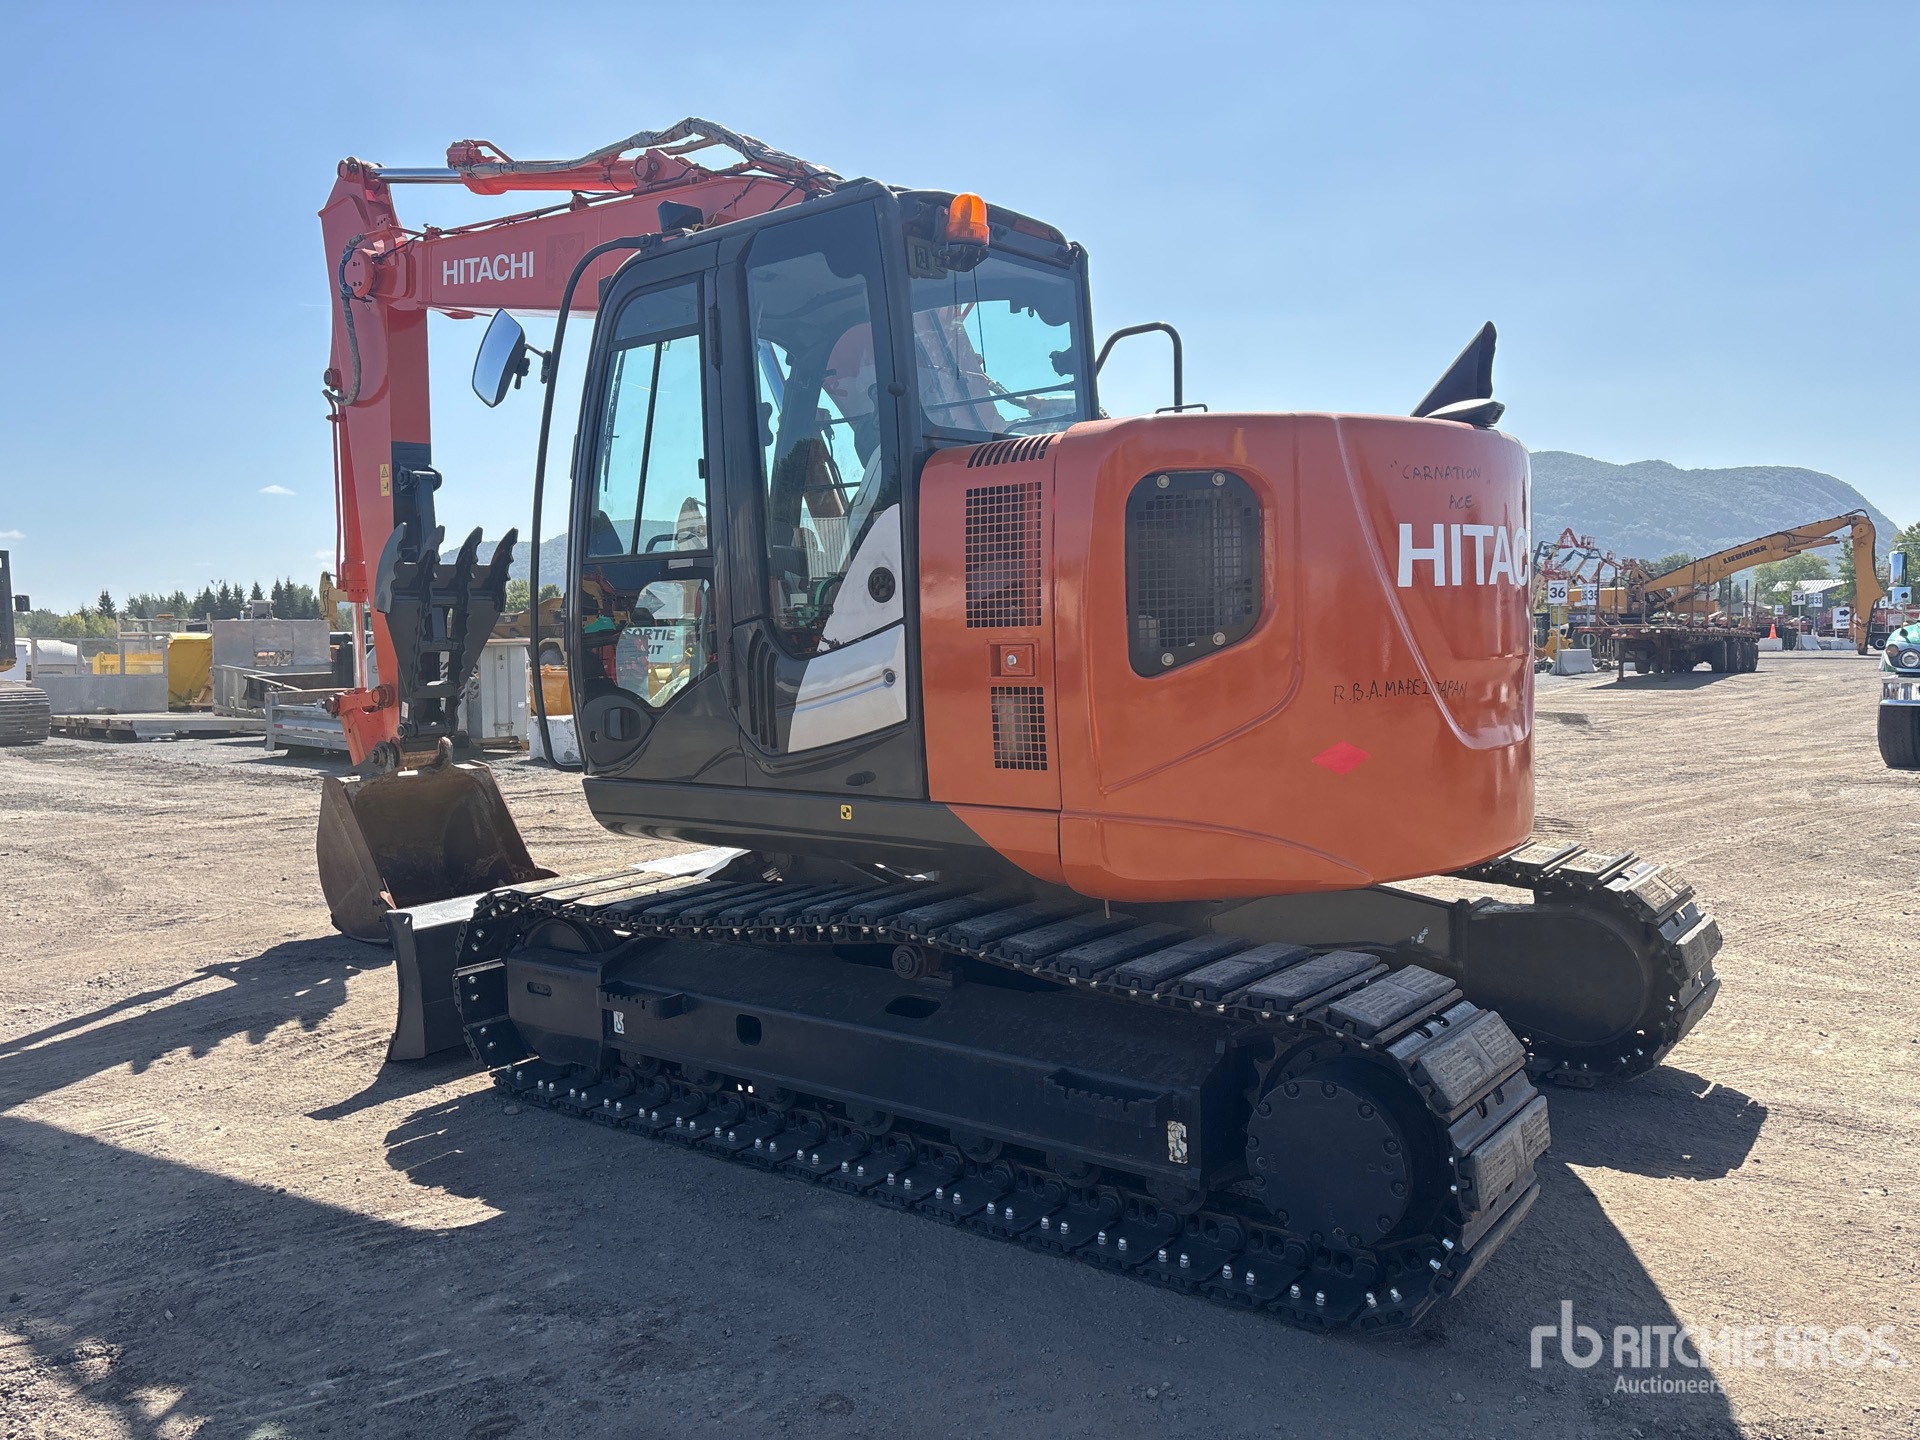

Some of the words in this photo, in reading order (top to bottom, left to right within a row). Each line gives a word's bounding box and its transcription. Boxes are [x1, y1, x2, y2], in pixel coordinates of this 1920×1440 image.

[442, 250, 535, 286] HITACHI
[1449, 494, 1475, 510] ACE
[1397, 522, 1529, 588] HITAC
[1722, 545, 1768, 564] LIEBHERR
[1549, 586, 1566, 599] 36
[1588, 589, 1598, 601] 35
[1791, 594, 1805, 602] 34
[1814, 596, 1823, 605] 33
